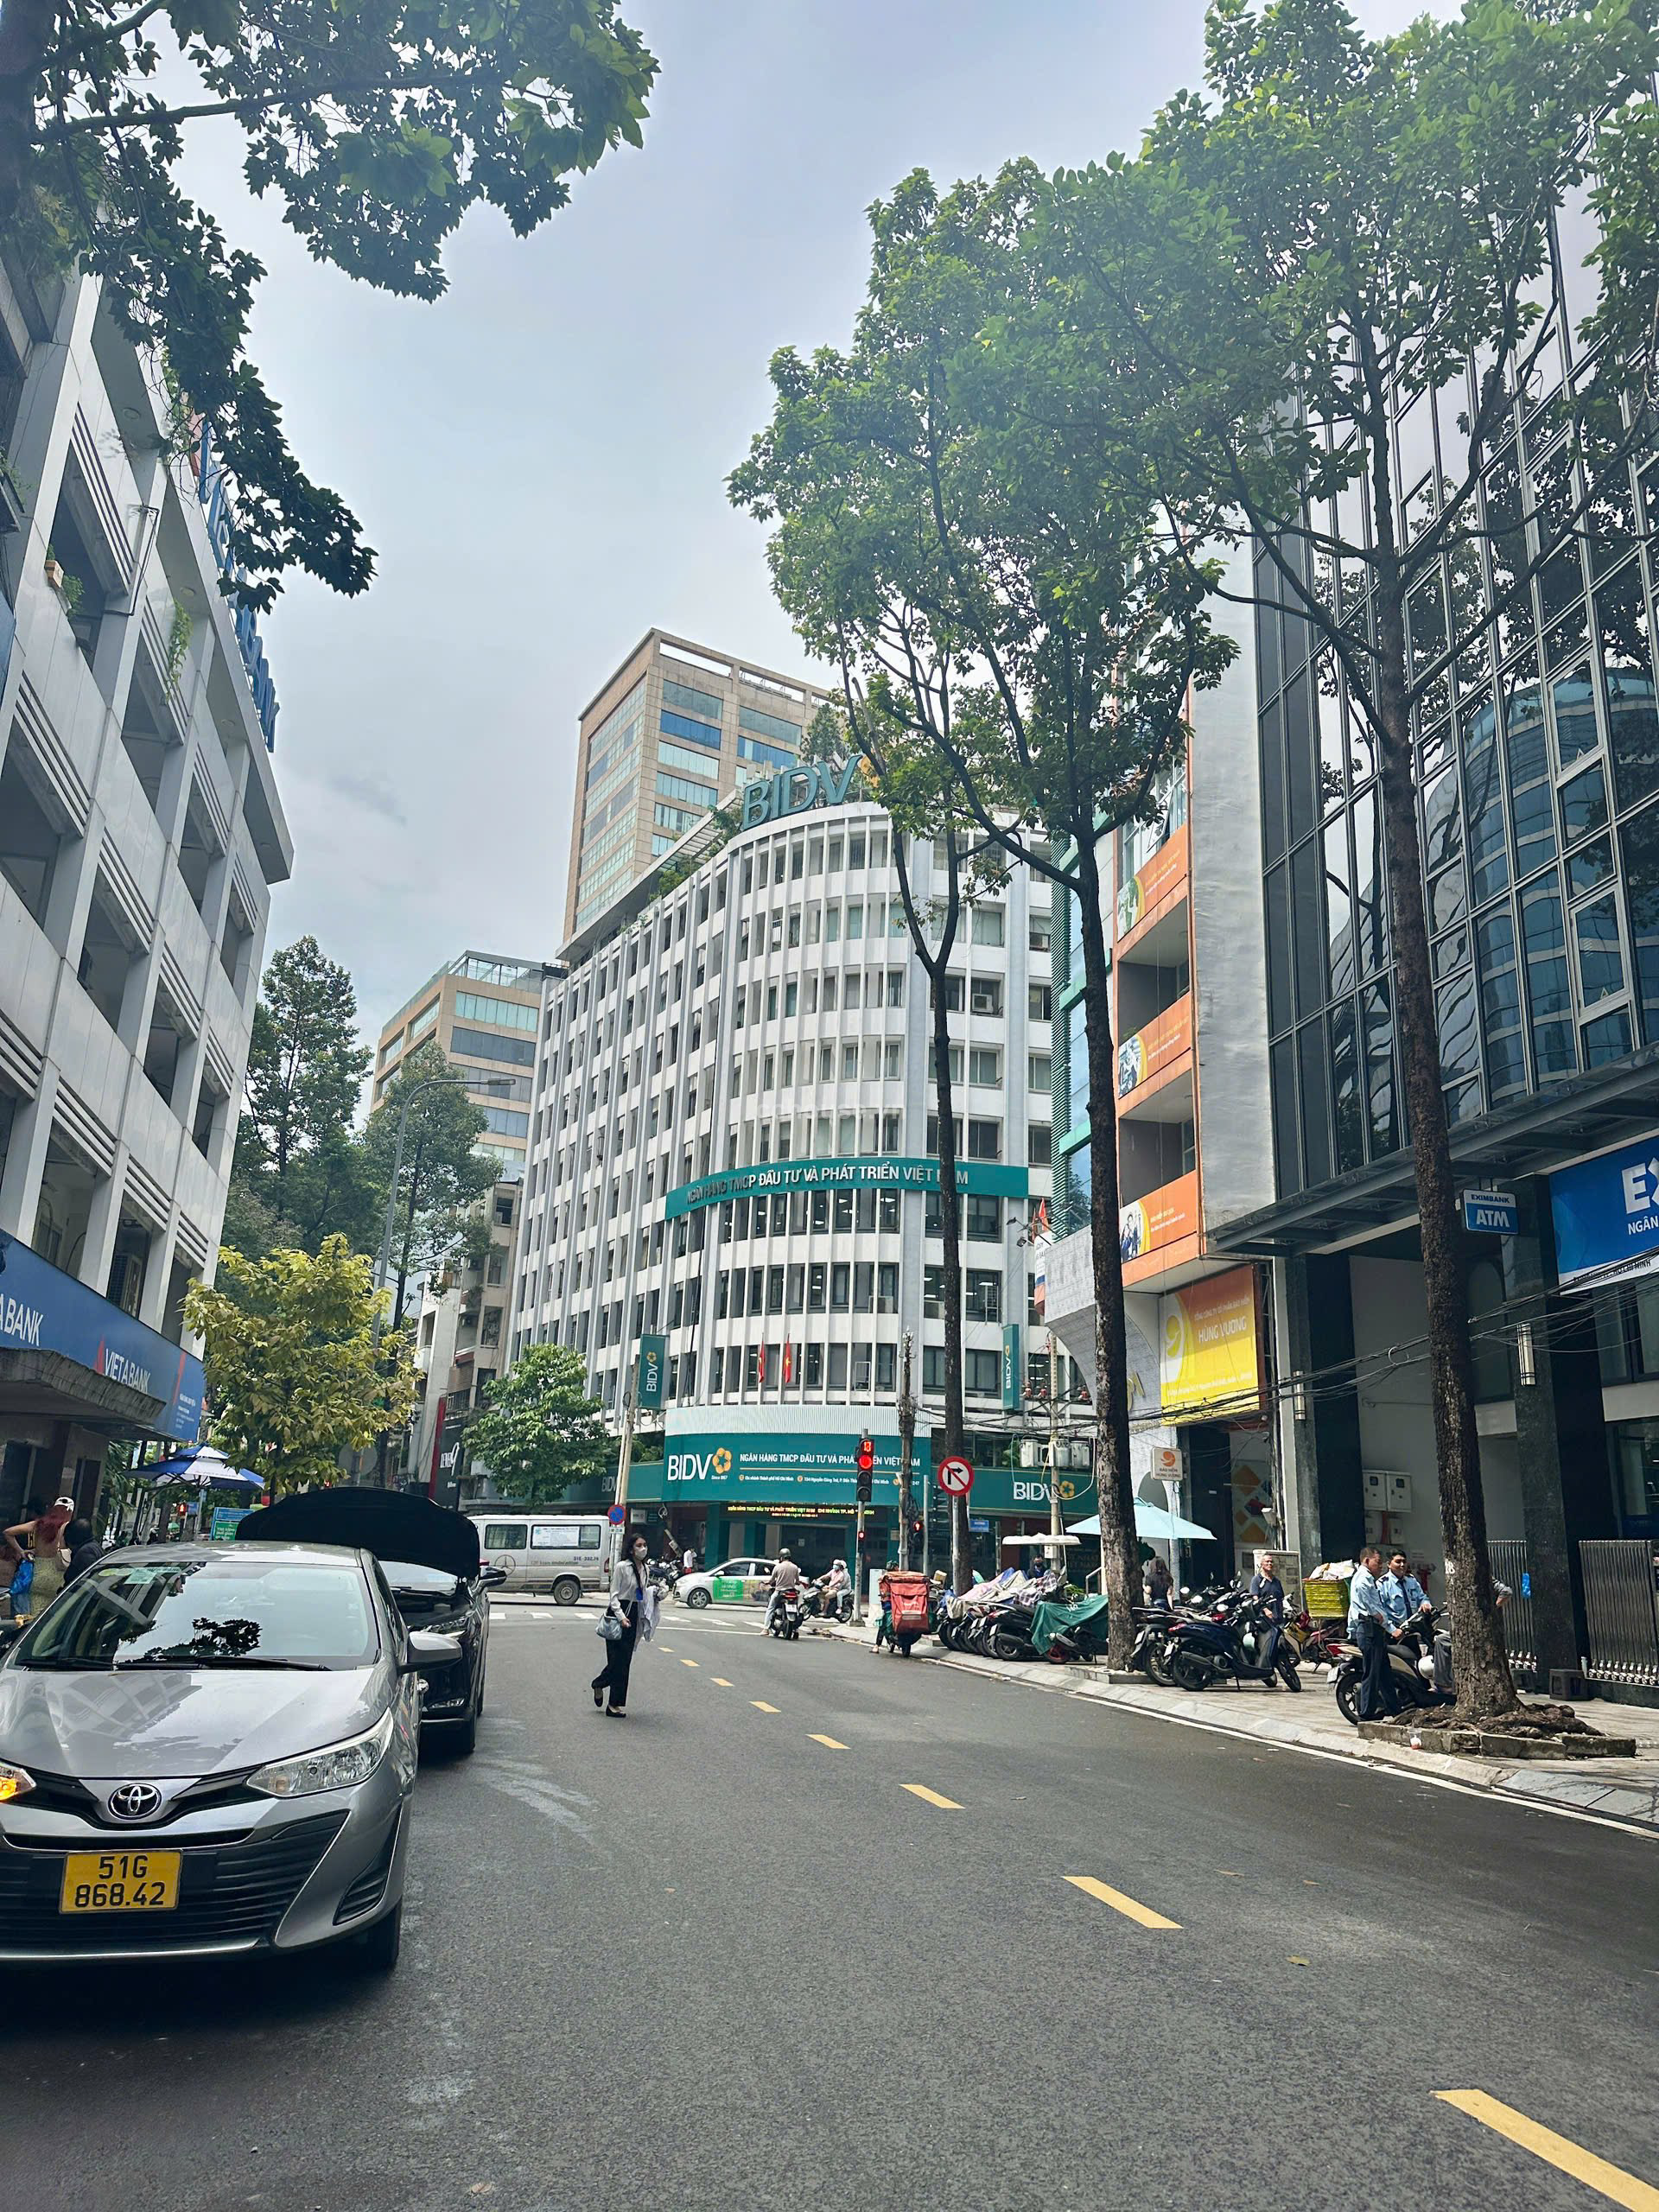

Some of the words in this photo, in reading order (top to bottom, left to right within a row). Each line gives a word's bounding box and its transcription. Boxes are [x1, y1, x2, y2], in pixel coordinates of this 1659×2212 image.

[741, 755, 863, 831] BIDV
[729, 1175, 756, 1191] TMCP
[759, 1169, 781, 1186] ĐẦU
[784, 1169, 802, 1184] TƯ
[804, 1166, 819, 1182] VÀ
[821, 1163, 855, 1180] PHÁT
[859, 1160, 899, 1179] TRIỂN
[902, 1165, 933, 1184] VIỆT
[1471, 1193, 1510, 1204] EXIMBANK
[1476, 1209, 1510, 1228] ATM
[1198, 1323, 1219, 1344] HÙNG
[1219, 1315, 1247, 1337] VƯƠNG
[105, 1348, 151, 1395] VIETABANK
[646, 1363, 658, 1392] BIDV
[667, 1453, 714, 1480] BIDV
[740, 1452, 758, 1462] NGÂN
[759, 1452, 779, 1462] HÀNG
[779, 1453, 799, 1463] TMCP
[800, 1452, 815, 1464] ĐẦU
[816, 1454, 827, 1464] TƯ
[828, 1454, 838, 1464] VÀ
[840, 1454, 858, 1465] PHÁ
[884, 1456, 900, 1467] VIỆT
[99, 1855, 148, 1879] 51G
[74, 1882, 166, 1908] 868.42
